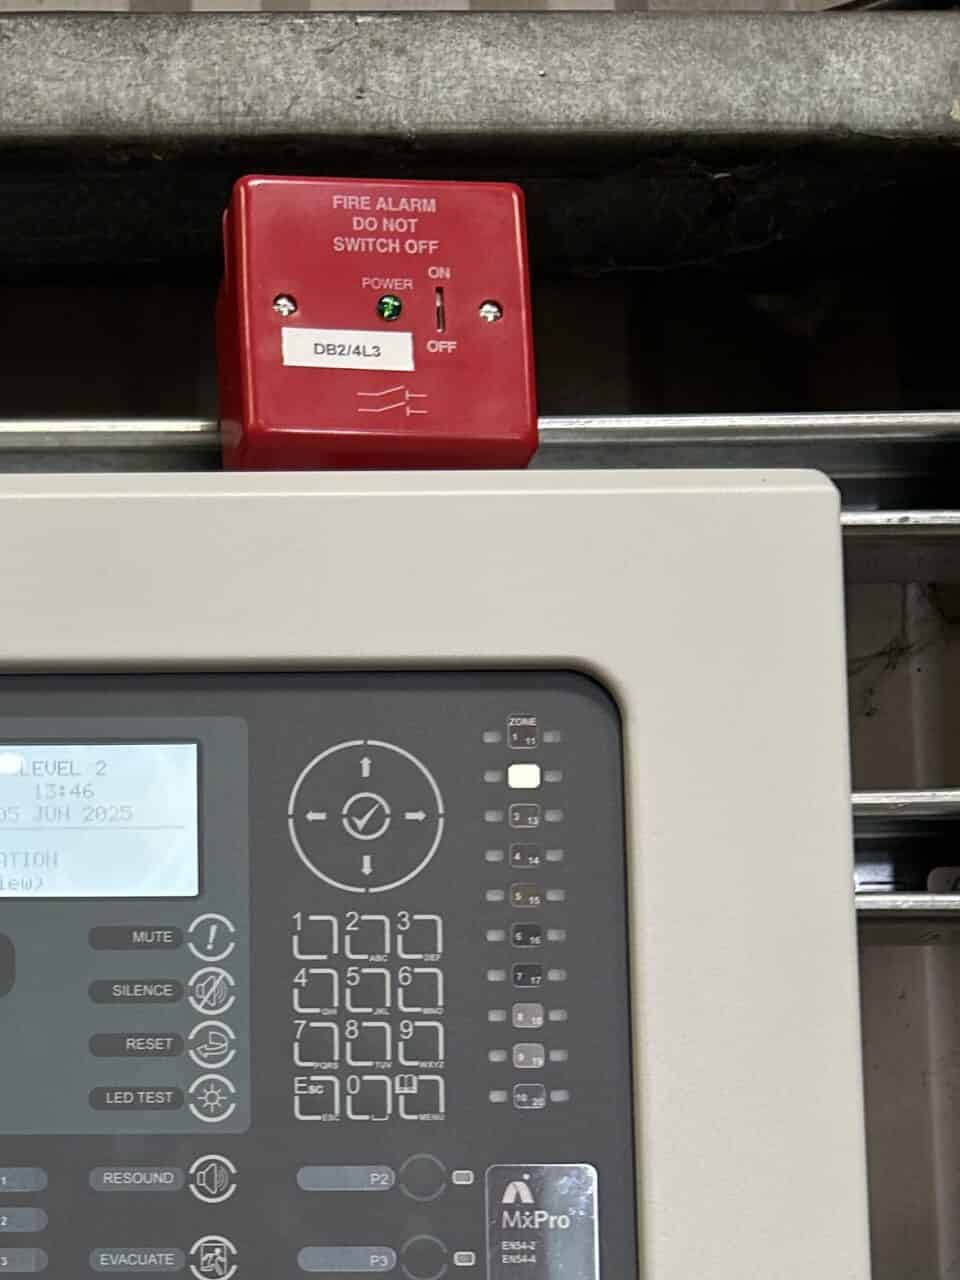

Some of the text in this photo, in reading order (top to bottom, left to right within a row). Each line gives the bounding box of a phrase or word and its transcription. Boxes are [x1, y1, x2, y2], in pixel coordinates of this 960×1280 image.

[332, 195, 436, 212] FIRE ALARM
[352, 216, 419, 233] DO NOT
[333, 236, 440, 254] SWITCH OFF
[428, 266, 450, 279] ON
[362, 277, 413, 290] POWER
[313, 342, 381, 358] DB2/4L3
[426, 341, 456, 353] OFF
[20, 759, 108, 776] LEVEL 2
[35, 783, 96, 800] 13:46
[32, 806, 71, 822] JUN
[82, 805, 134, 822] 2025
[292, 911, 302, 931] 1
[345, 911, 360, 931] 2
[397, 911, 411, 930] 3
[132, 931, 173, 943] MUTE
[293, 967, 308, 987] 4
[346, 966, 360, 986] 5
[398, 966, 412, 986] 6
[112, 984, 173, 996] SILENCE
[293, 1020, 307, 1039] 7
[345, 1019, 359, 1039] 8
[399, 1019, 414, 1039] 9
[126, 1038, 173, 1050] RESET
[347, 1075, 360, 1095] 0
[106, 1092, 173, 1104] LED TEST
[1, 1176, 7, 1186] 1
[103, 1172, 174, 1184] RESOUND
[369, 1173, 389, 1185] P2
[0, 1216, 8, 1226] 2
[501, 1210, 570, 1229] MxPro
[0, 1256, 8, 1267] 3
[100, 1254, 175, 1266] EVACUATE
[369, 1255, 389, 1267] P3
